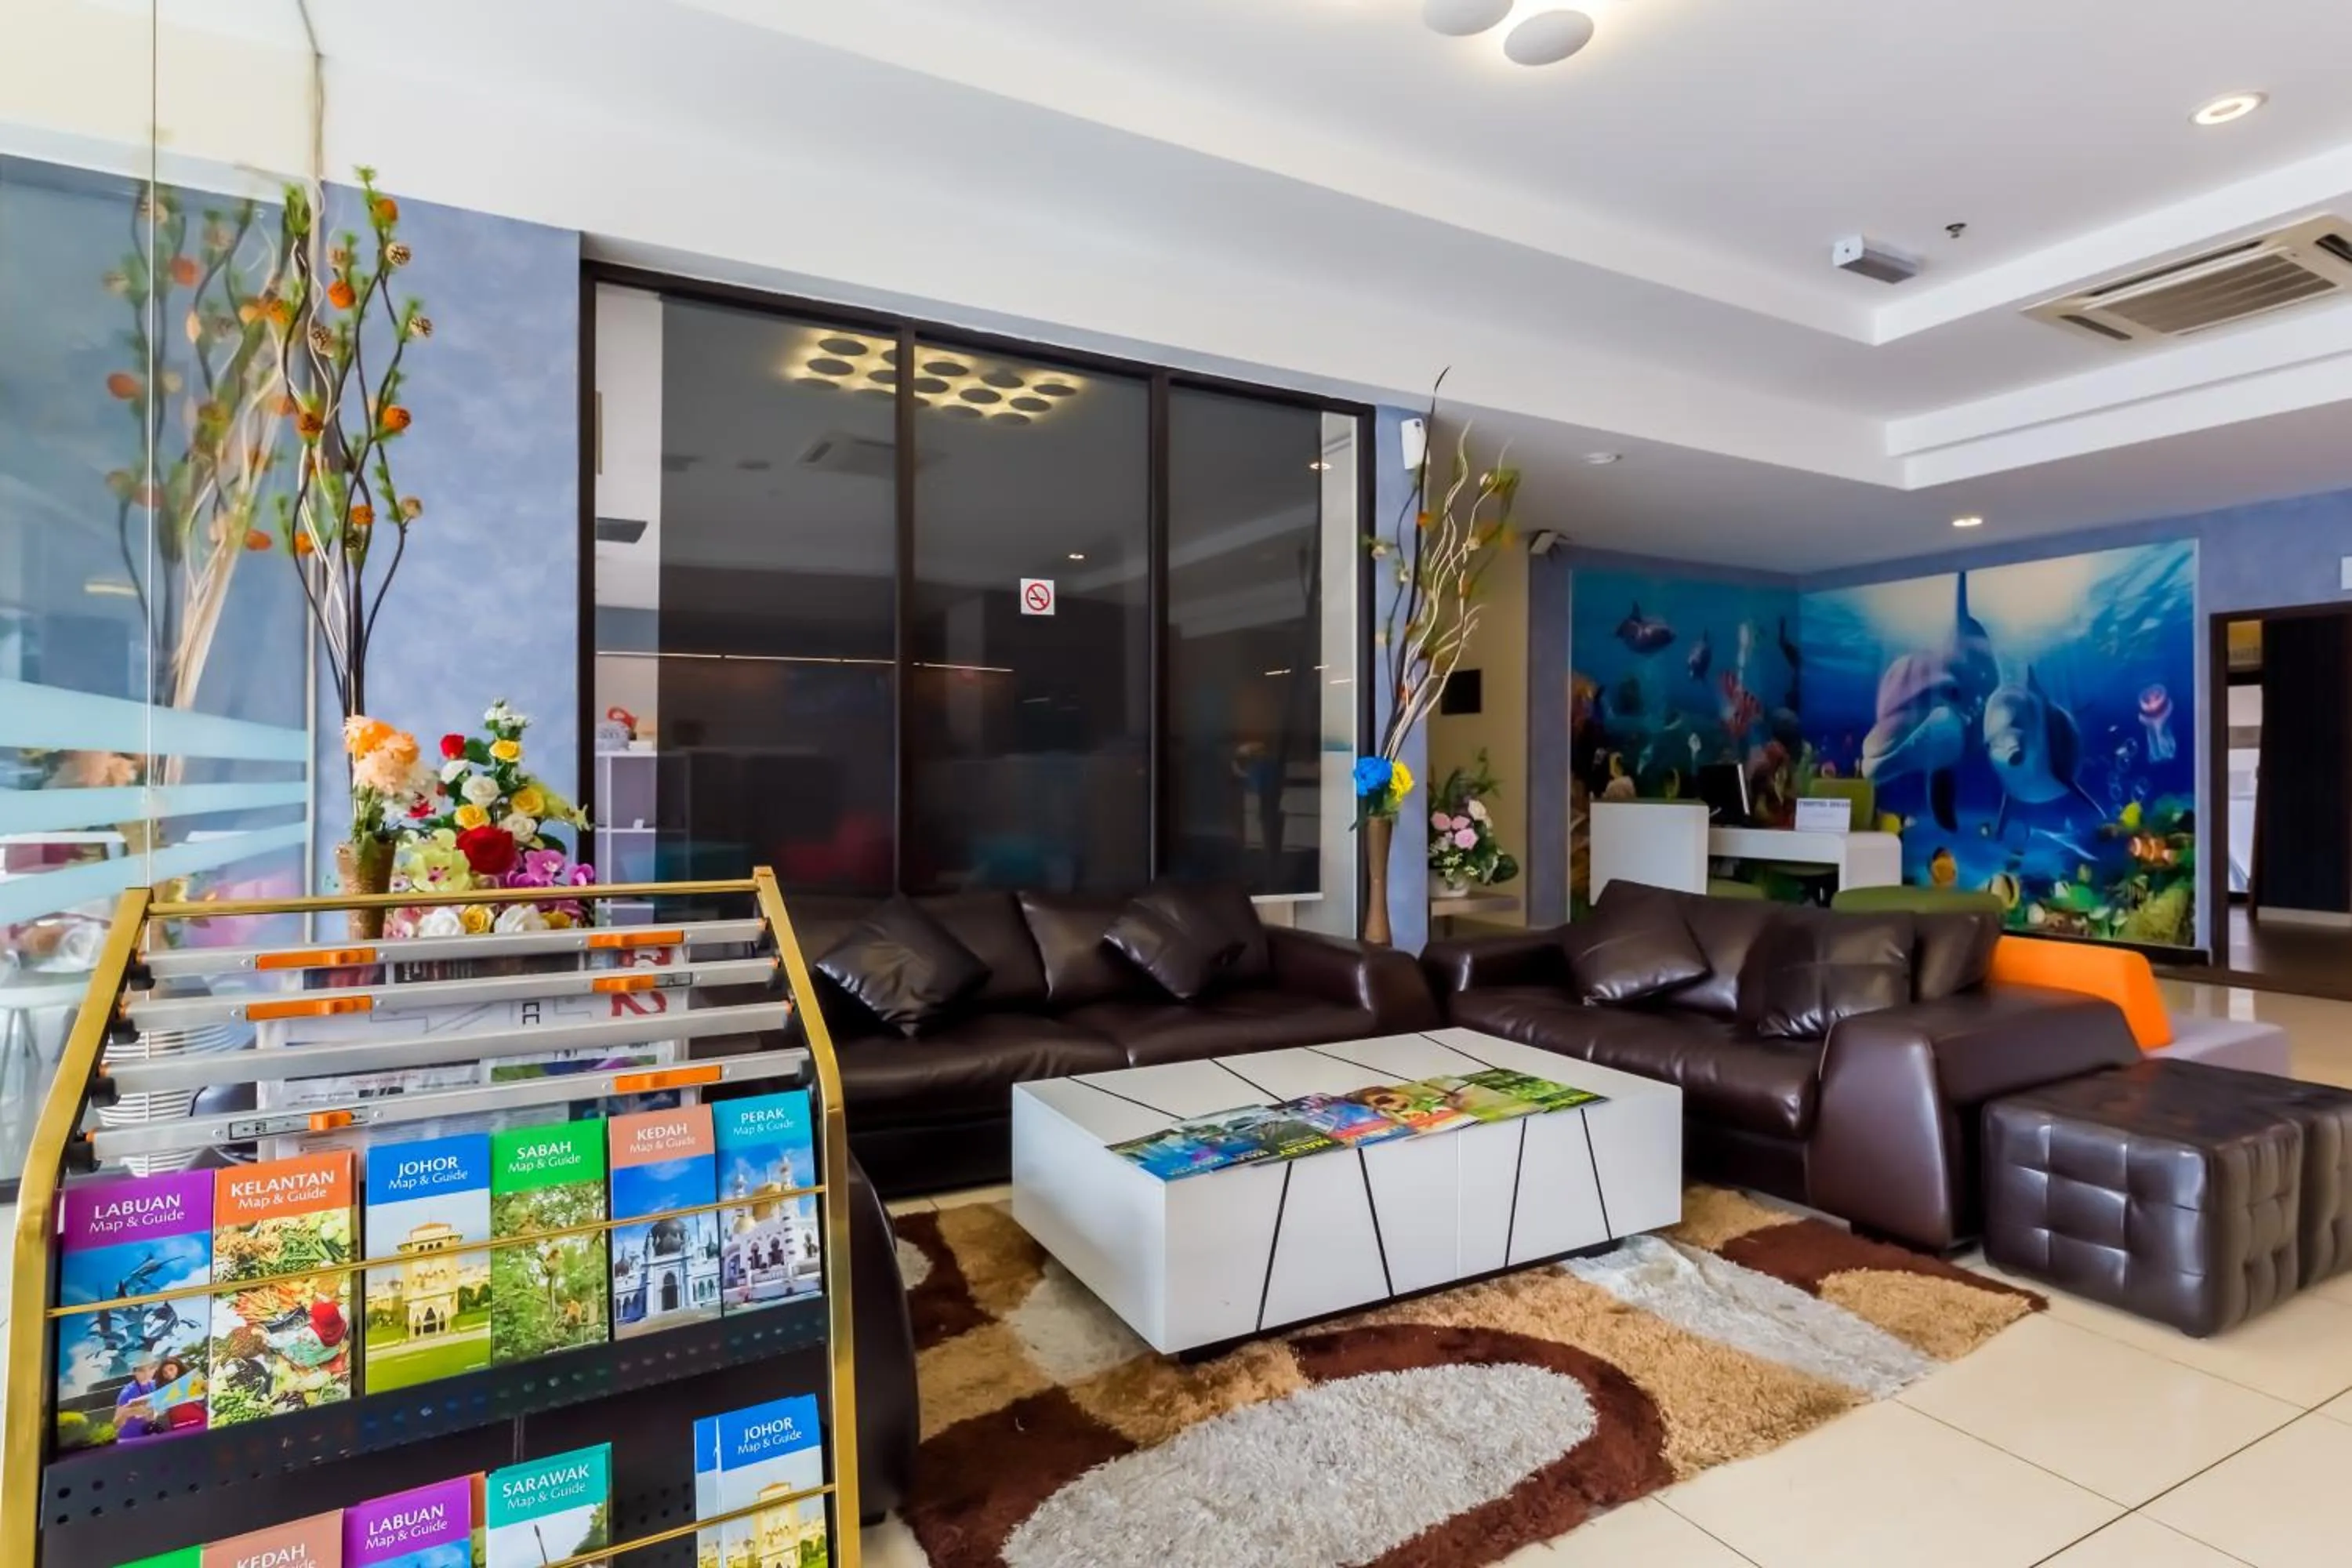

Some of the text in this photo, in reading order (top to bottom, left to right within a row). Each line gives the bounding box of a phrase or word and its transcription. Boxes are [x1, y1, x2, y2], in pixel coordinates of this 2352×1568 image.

[741, 1108, 785, 1123] PERAK
[637, 1123, 688, 1141] KEDAH
[733, 1125, 754, 1136] Map
[757, 1123, 764, 1132] &
[517, 1141, 572, 1160] SABAH
[630, 1136, 696, 1153] Map & Guide
[398, 1156, 458, 1178] JOHOR
[508, 1153, 581, 1173] Map & Guide
[231, 1170, 335, 1197] KELANTAN
[388, 1170, 468, 1189] Map & Guide
[95, 1193, 180, 1219] LABUAN
[238, 1187, 327, 1210] Map & Guide
[89, 1209, 185, 1233] Map & Guide
[745, 1417, 793, 1443] JOHOR
[738, 1430, 802, 1455] Map & Guide
[503, 1463, 590, 1498] SARAWAK
[508, 1482, 586, 1510] Map & Guide
[369, 1503, 444, 1535] LABUAN
[365, 1519, 448, 1549] Map & Guide
[238, 1542, 305, 1568] KEDAH
